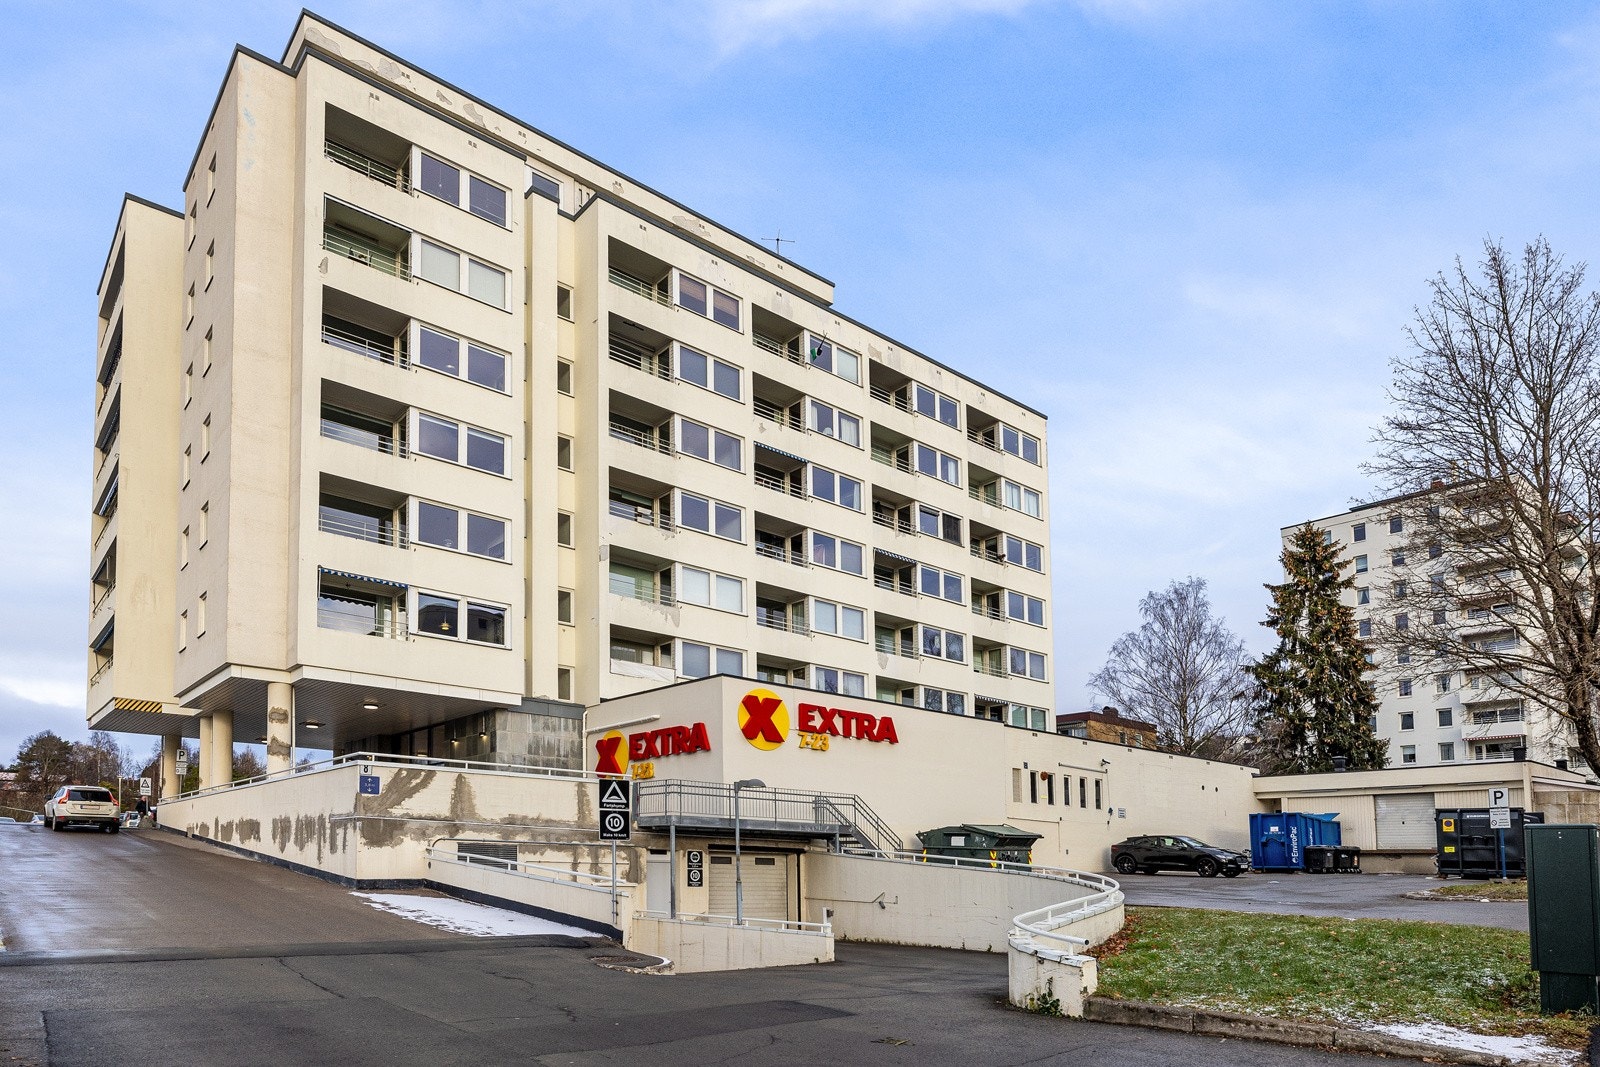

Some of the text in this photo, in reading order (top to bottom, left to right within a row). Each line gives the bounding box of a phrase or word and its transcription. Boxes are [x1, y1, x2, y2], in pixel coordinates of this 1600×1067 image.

[741, 694, 899, 744] X EXTRA
[629, 722, 711, 761] EXTRA
[797, 731, 829, 751] 7-23
[178, 750, 185, 760] P
[1493, 790, 1504, 805] P
[610, 818, 620, 827] 10
